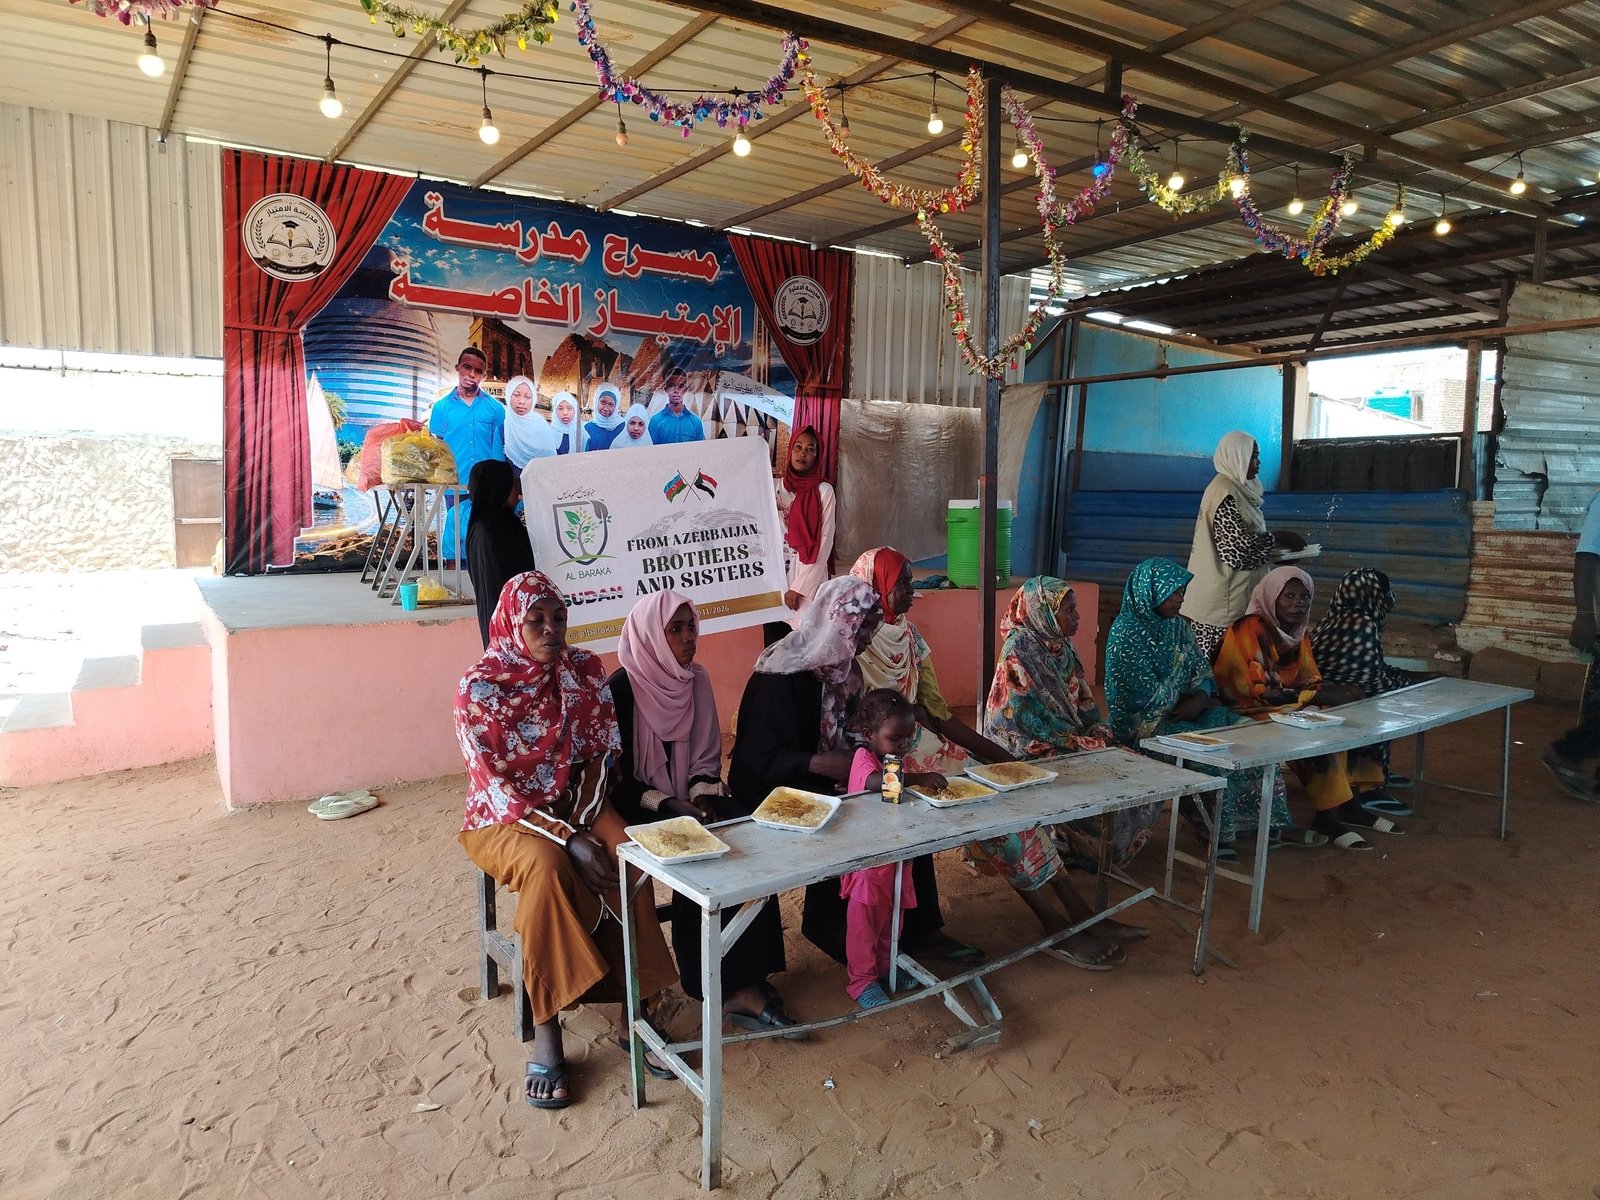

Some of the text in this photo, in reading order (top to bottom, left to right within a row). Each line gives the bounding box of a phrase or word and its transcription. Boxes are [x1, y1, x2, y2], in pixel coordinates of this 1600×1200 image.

[294, 207, 318, 224] مدرسة
[422, 191, 721, 282] مسرح مدرسة
[389, 258, 583, 325] الخاصة
[626, 523, 759, 553] FROM AZERBAIJAN
[565, 567, 612, 581] AL BARAKA
[642, 543, 750, 575] BROTHERS
[635, 561, 765, 596] AND SISTERS
[562, 585, 623, 608] SUDAN
